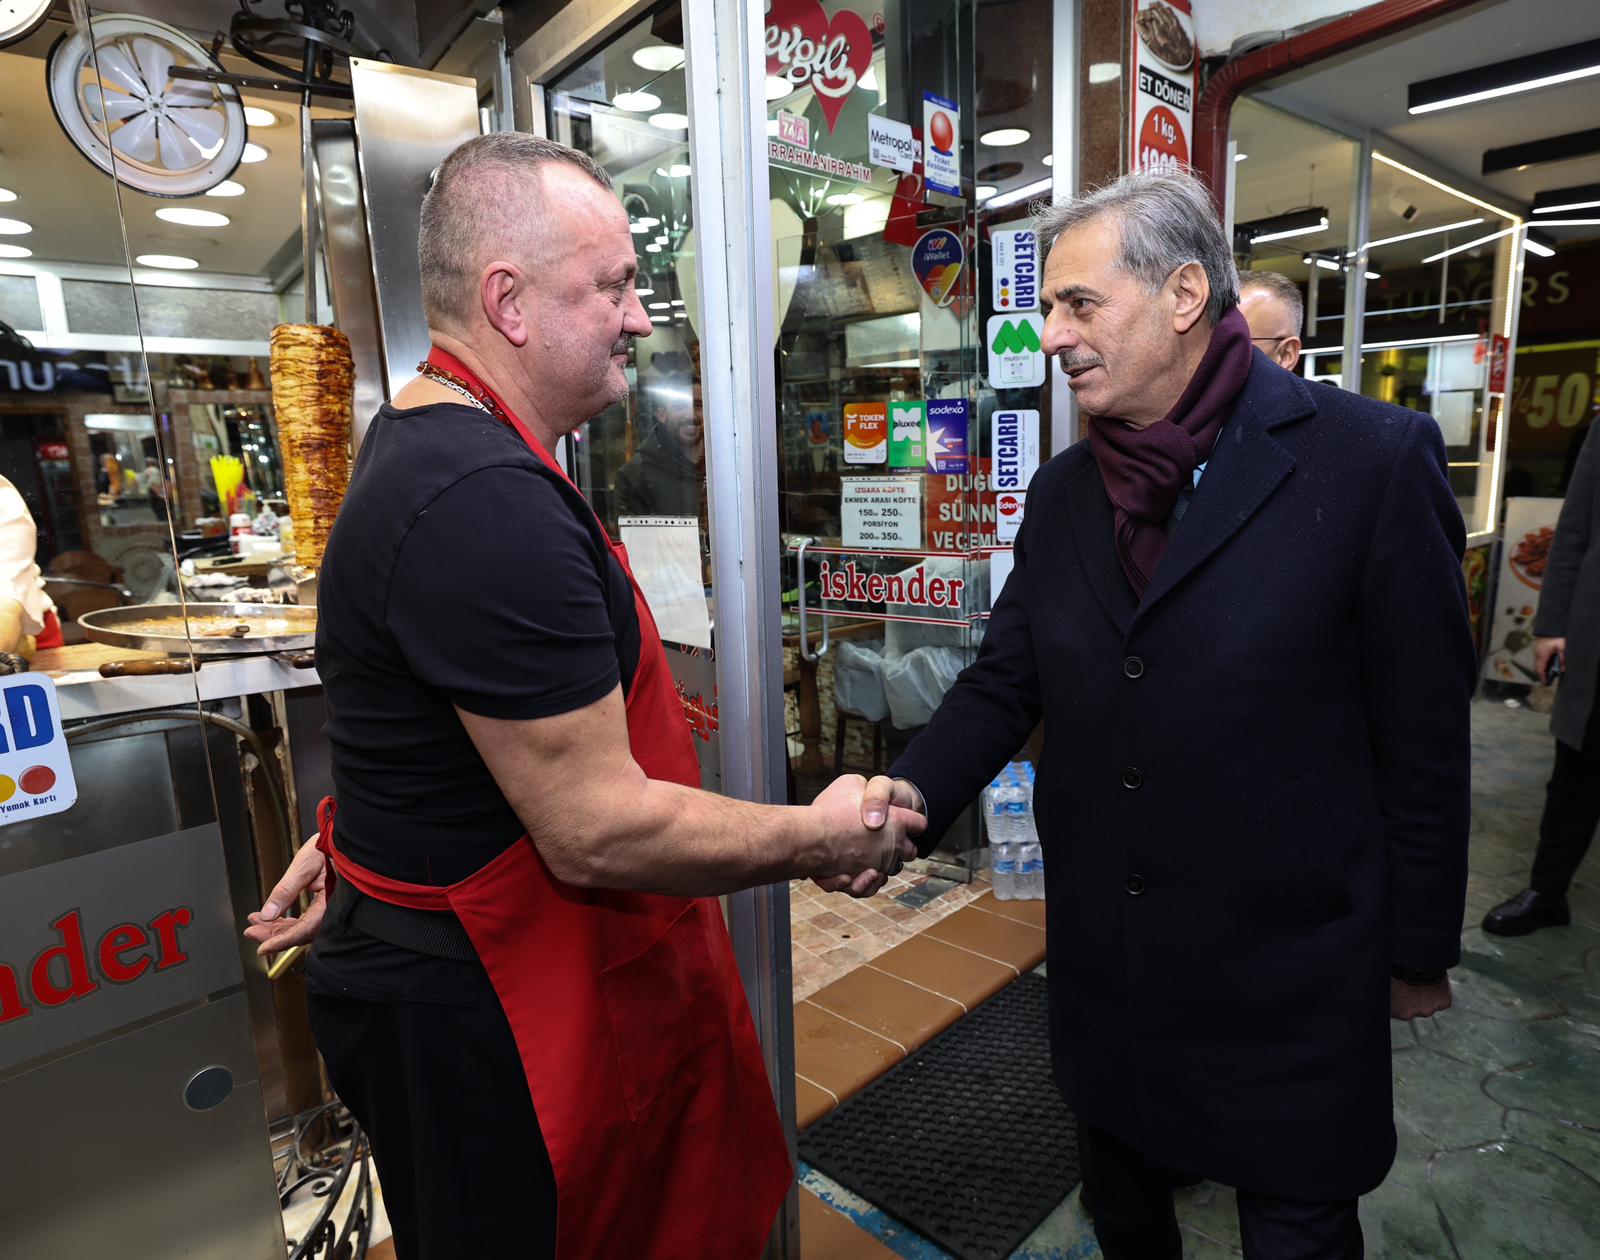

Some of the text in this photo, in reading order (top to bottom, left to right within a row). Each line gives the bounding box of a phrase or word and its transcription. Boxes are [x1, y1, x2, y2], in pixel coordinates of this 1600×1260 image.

[765, 0, 856, 98] evgili
[1140, 72, 1190, 109] ET DÖNER
[1153, 112, 1177, 144] 1 kg.
[871, 129, 912, 151] Metropol
[1014, 232, 1035, 308] SETCARD
[859, 414, 884, 422] TOKEN
[929, 401, 964, 415] sodexo
[859, 422, 878, 430] FLEX
[997, 413, 1018, 488] SETCARD
[863, 520, 898, 528] PORSİYON
[933, 531, 954, 549] VE
[820, 561, 965, 608] iskender
[33, 794, 57, 806] Kartı
